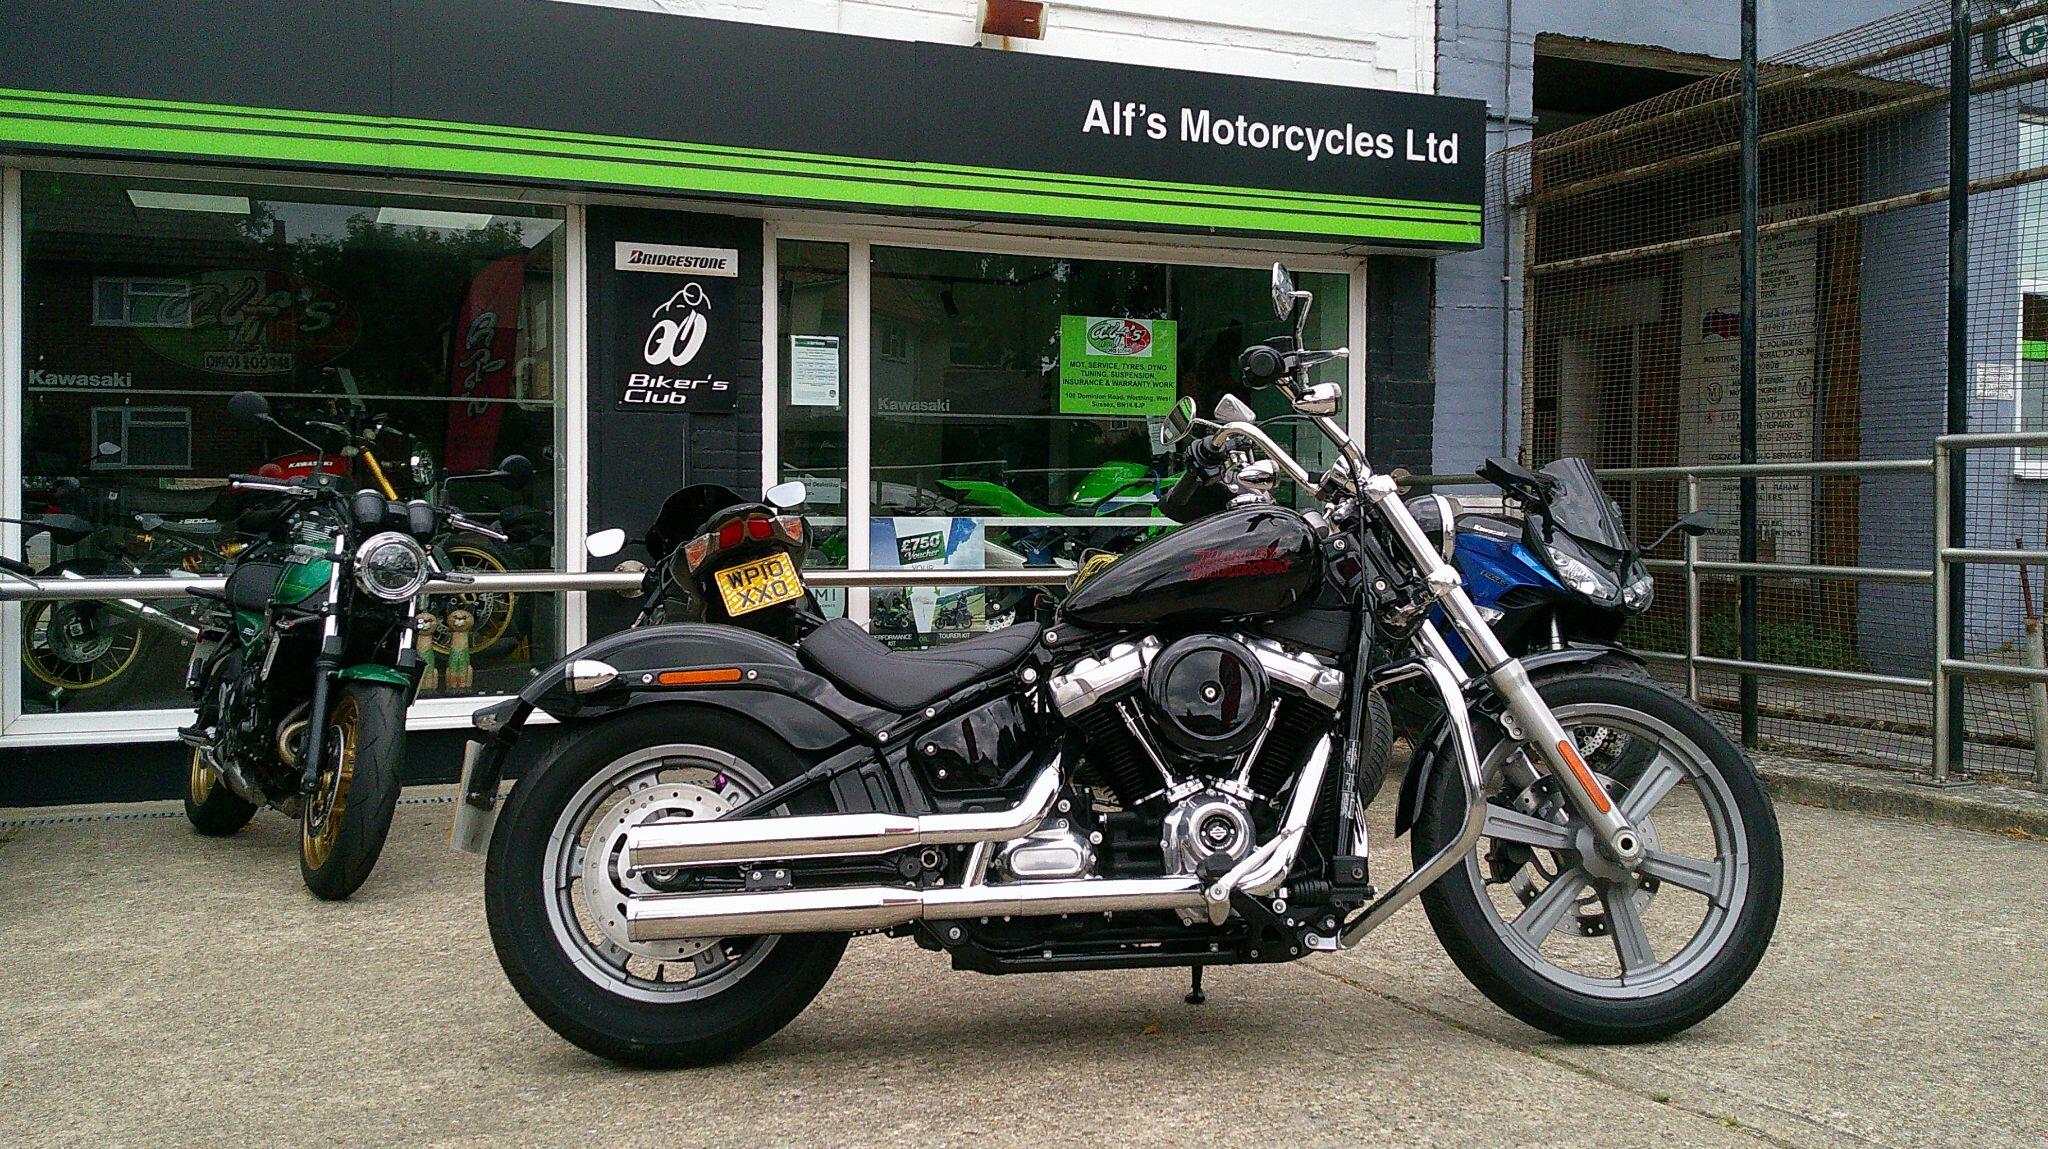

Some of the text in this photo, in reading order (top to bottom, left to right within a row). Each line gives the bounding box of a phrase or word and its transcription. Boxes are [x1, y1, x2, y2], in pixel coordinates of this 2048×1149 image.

[1082, 99, 1459, 165] Alf's Motorcycles Ltd
[628, 249, 728, 270] BRIDGESTONE
[28, 369, 132, 388] Kawasaki
[628, 373, 730, 391] Biker's
[1062, 378, 1104, 387] INSURANCE
[1112, 380, 1151, 388] WARRANTY
[1152, 381, 1174, 389] WORK
[1110, 371, 1156, 380] SUSPENSION,
[623, 388, 687, 405] Club
[1077, 392, 1107, 400] Dominion
[878, 398, 951, 413] Kawasaki
[900, 533, 940, 553] £750
[904, 549, 940, 561] Voucher
